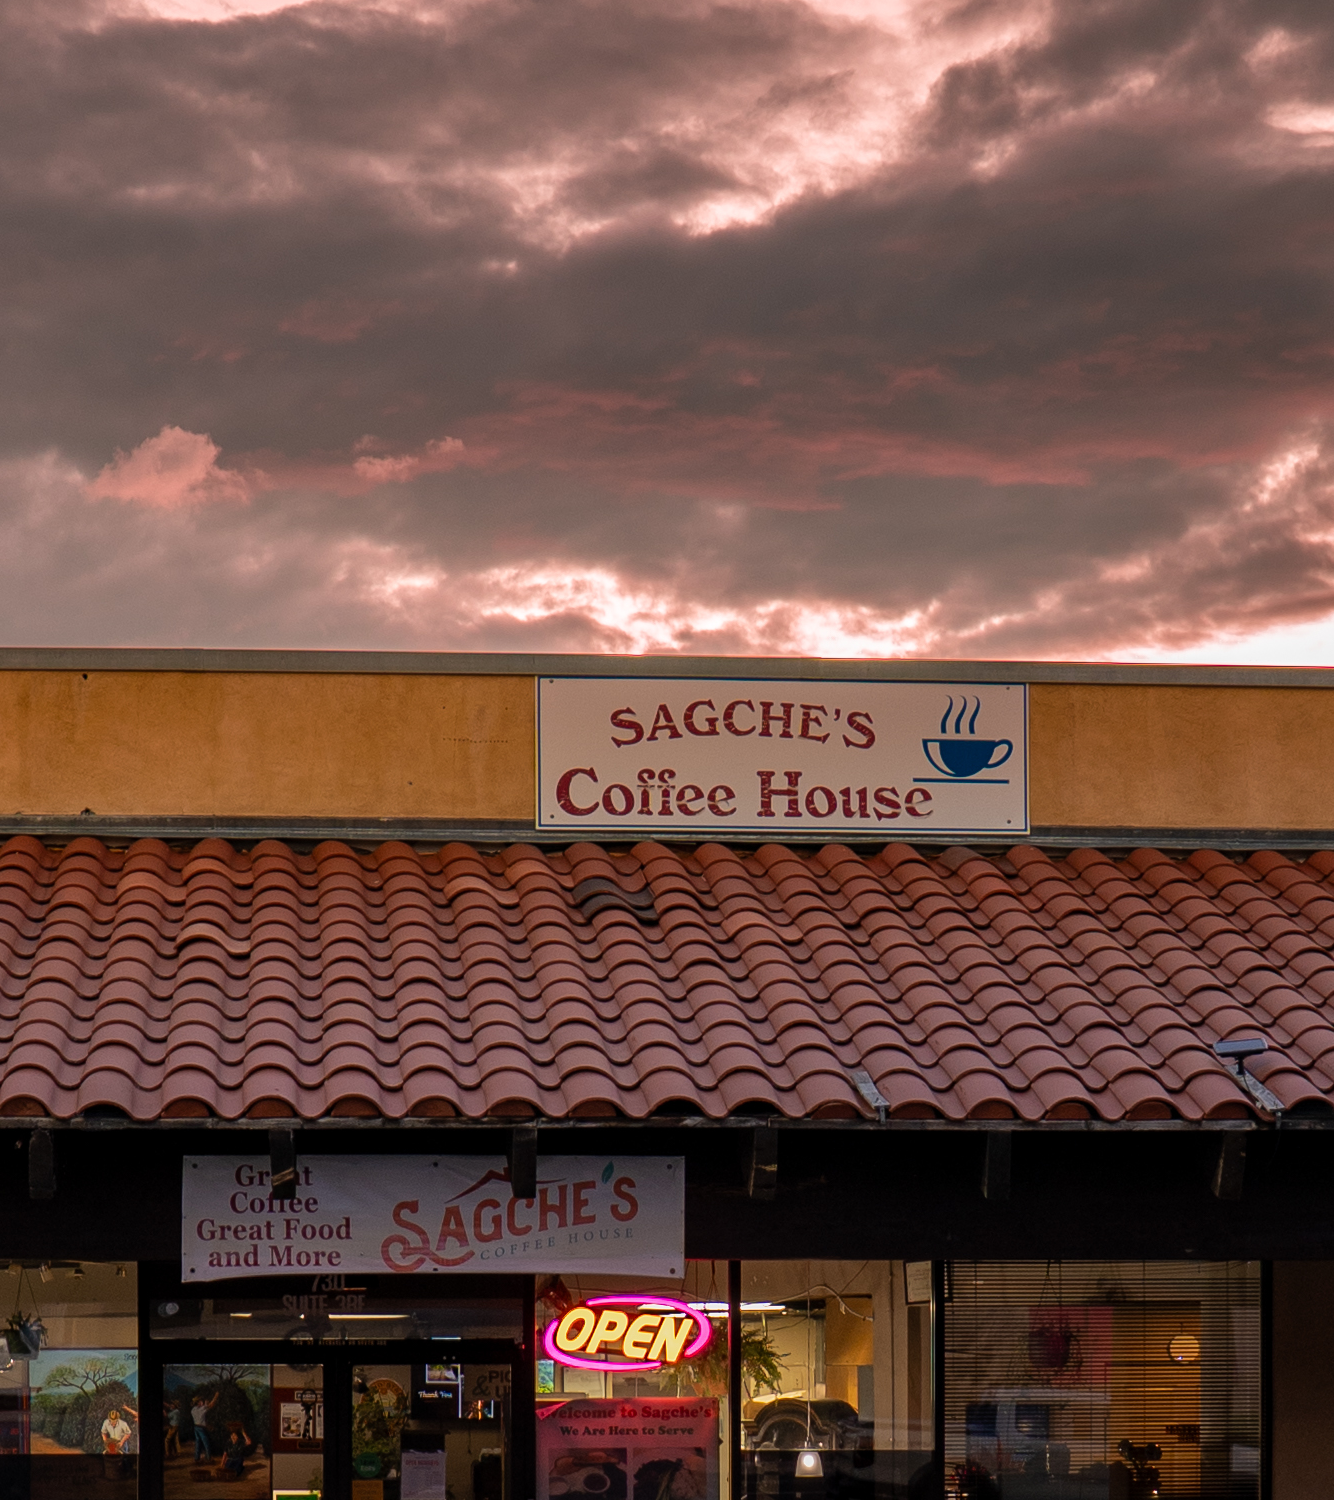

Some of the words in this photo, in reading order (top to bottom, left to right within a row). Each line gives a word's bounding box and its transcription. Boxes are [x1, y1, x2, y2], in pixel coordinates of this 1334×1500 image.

[610, 699, 875, 748] SAGCHE'S
[556, 766, 737, 816] Coffee
[757, 770, 933, 821] House
[235, 1164, 313, 1187] Grt
[196, 1218, 275, 1241] Great
[283, 1217, 352, 1240] Food
[208, 1244, 259, 1267] and
[269, 1245, 341, 1267] More
[480, 1236, 555, 1260] COFFEE
[569, 1227, 633, 1245] HOUSE
[555, 1306, 694, 1363] OPEN
[621, 1406, 637, 1418] to
[641, 1406, 712, 1420] Sagche's
[560, 1426, 579, 1436] We
[582, 1426, 605, 1436] Are
[609, 1426, 639, 1436] Here
[642, 1426, 655, 1436] to
[658, 1426, 694, 1436] Serve
